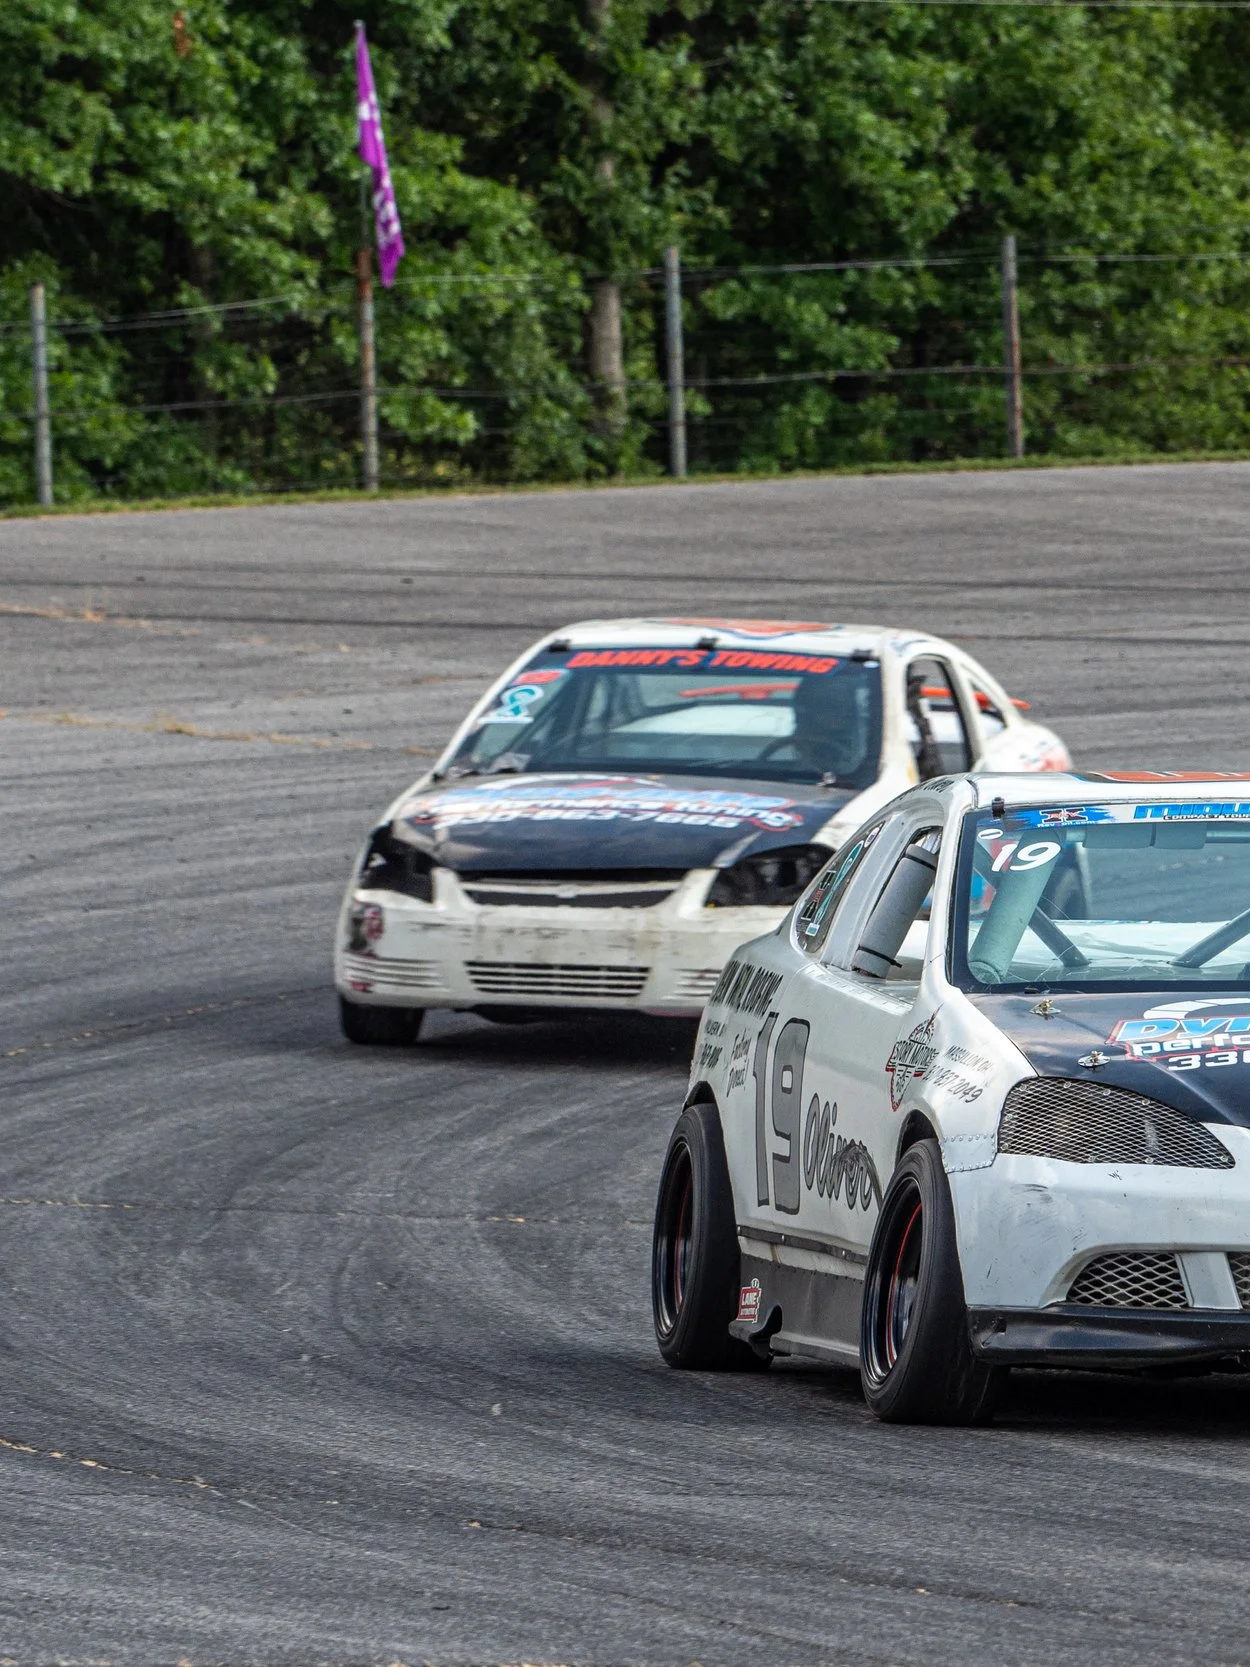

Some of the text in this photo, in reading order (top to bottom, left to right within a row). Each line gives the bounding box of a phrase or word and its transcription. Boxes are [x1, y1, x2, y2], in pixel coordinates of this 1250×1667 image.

[566, 650, 839, 674] DANNY'S TOWING
[992, 842, 1061, 872] 19
[752, 1011, 811, 1215] 19
